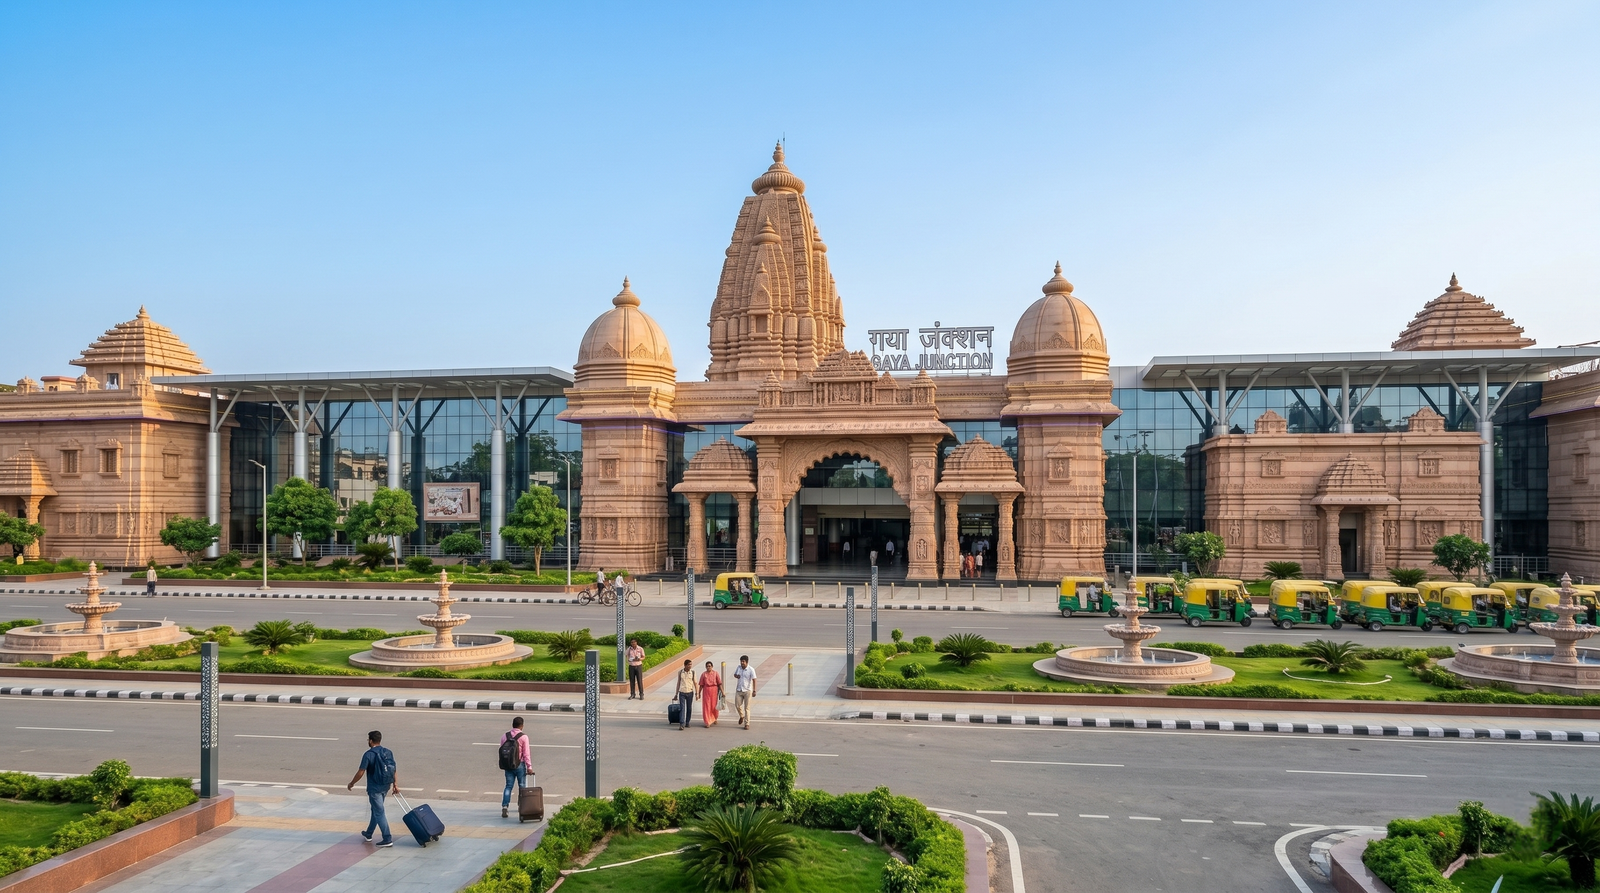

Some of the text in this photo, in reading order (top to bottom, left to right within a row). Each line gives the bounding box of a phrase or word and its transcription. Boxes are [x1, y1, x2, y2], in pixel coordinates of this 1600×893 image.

[868, 321, 994, 351] गया जंक्शन
[871, 353, 993, 370] GAYA JUNCTION
